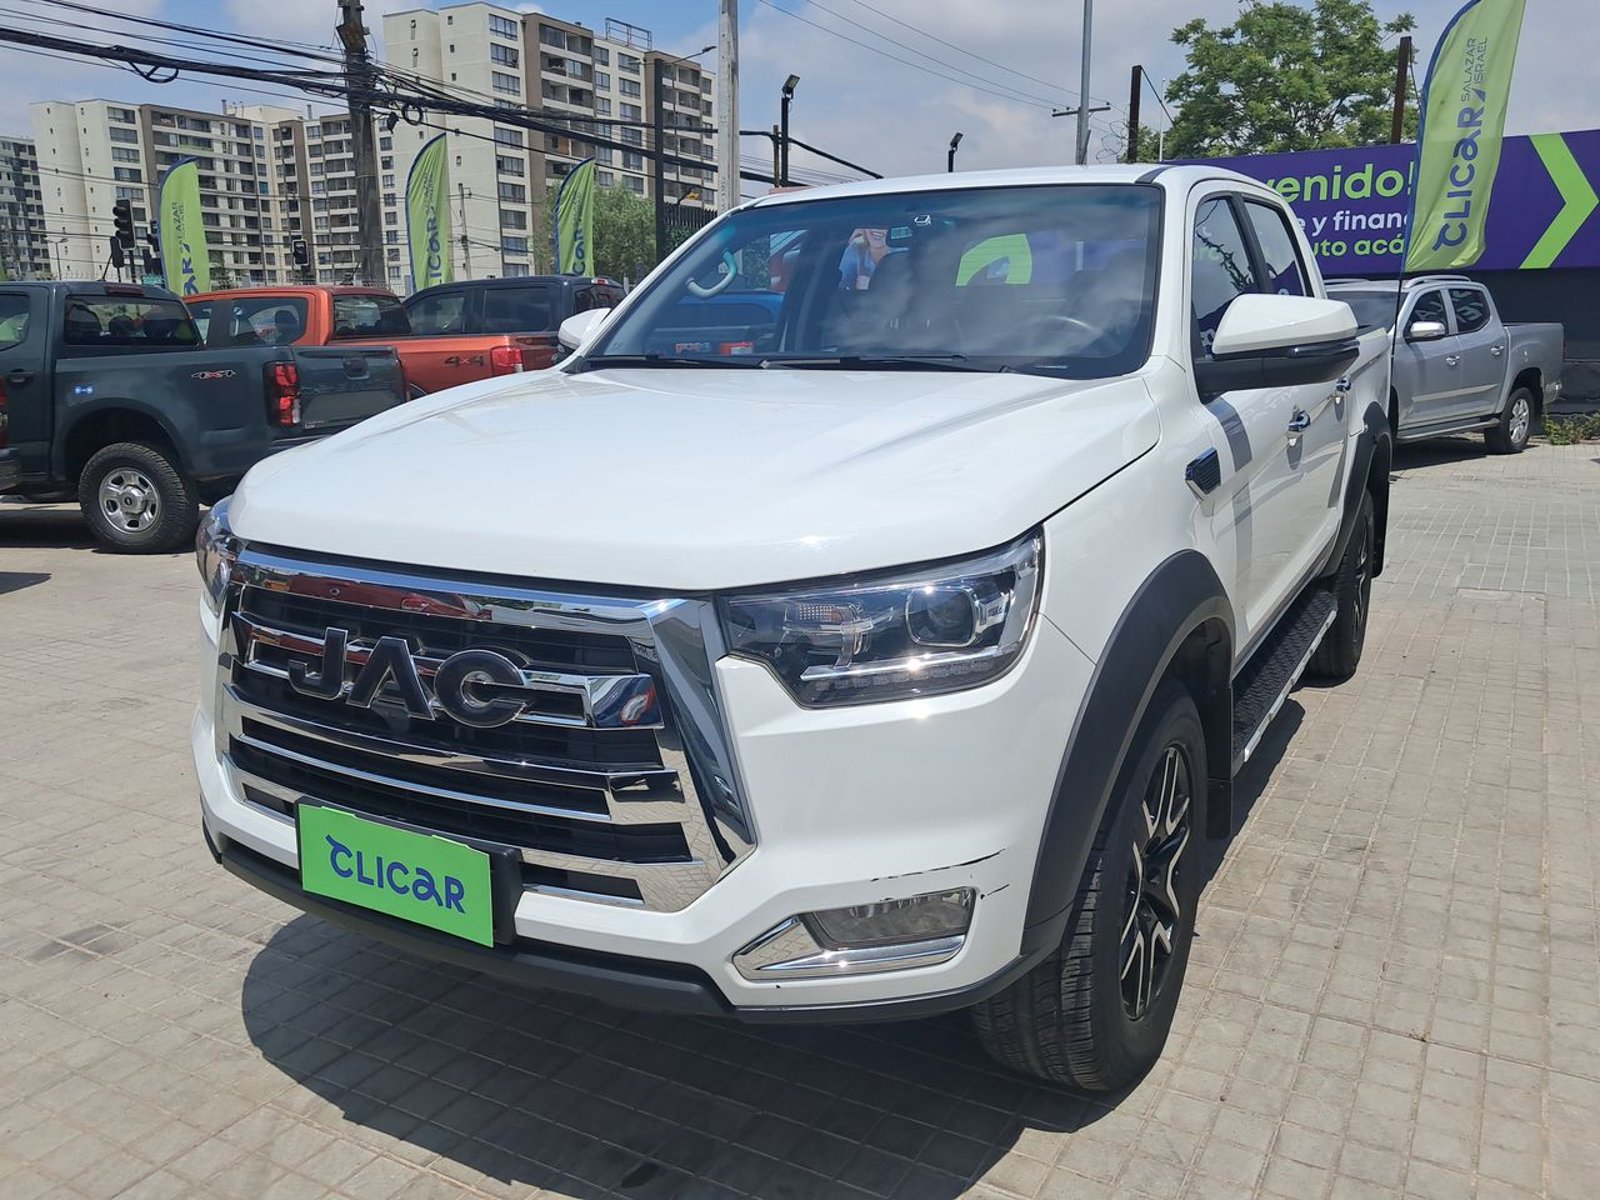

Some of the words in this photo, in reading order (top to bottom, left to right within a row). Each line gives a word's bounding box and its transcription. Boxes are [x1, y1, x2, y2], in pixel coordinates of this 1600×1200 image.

[1460, 37, 1478, 102] SALAZAR
[1474, 37, 1488, 85] ISRAEL
[1311, 216, 1327, 237] y
[288, 626, 527, 729] JAC
